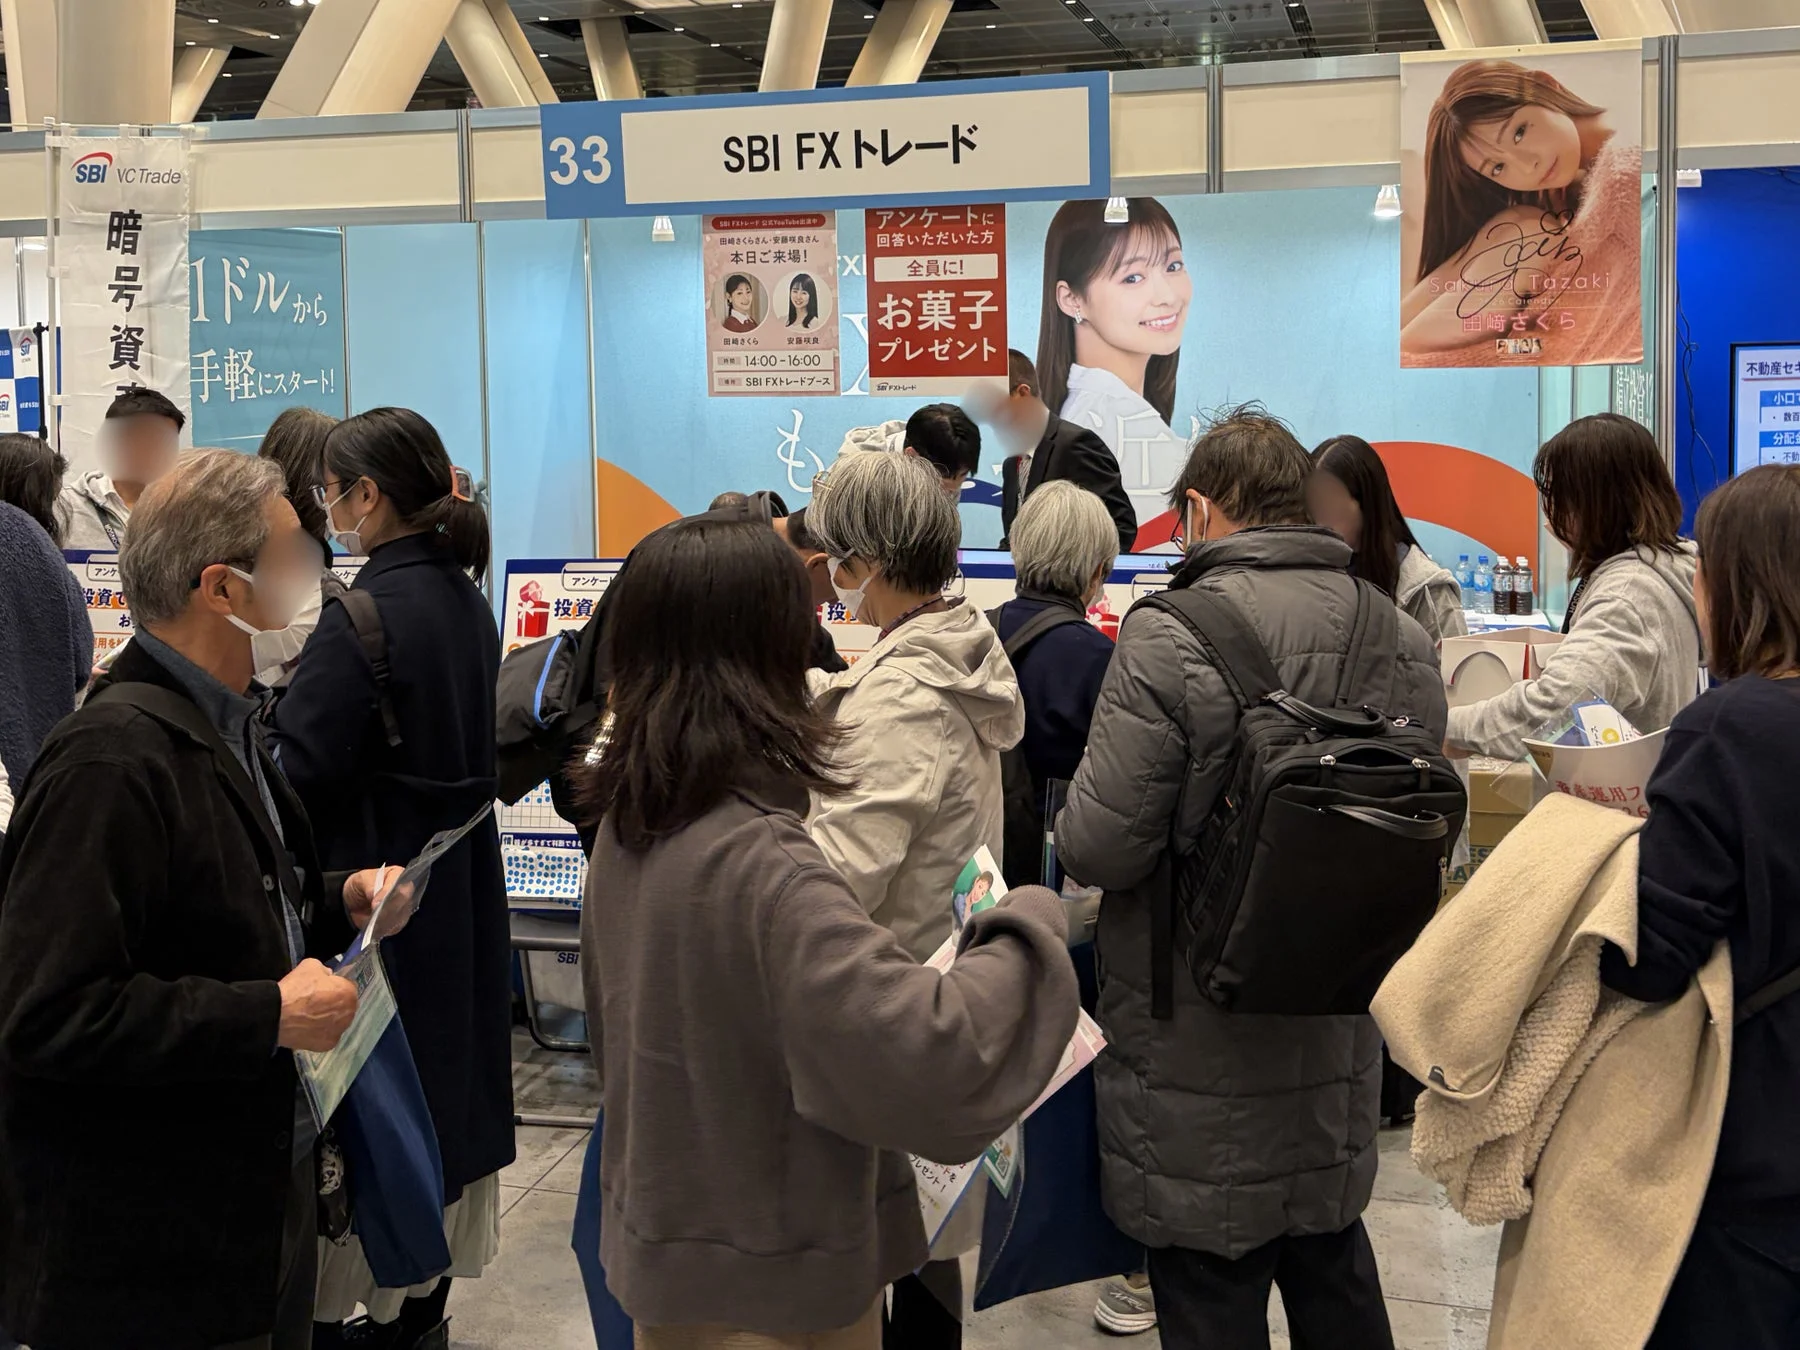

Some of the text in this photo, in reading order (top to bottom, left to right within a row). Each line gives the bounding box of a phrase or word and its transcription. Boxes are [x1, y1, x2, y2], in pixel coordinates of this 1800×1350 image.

[549, 135, 612, 186] 33
[723, 133, 780, 174] SBI
[75, 163, 182, 185] SBI VC Trade
[876, 206, 995, 230] アンケートに
[877, 229, 995, 248] 回答いただいた方
[906, 259, 964, 278] 全員に!
[190, 256, 328, 327] 1ドルから
[1529, 272, 1610, 290] Tazaki
[877, 290, 999, 332] お菓子
[878, 336, 997, 363] プレゼント
[190, 348, 335, 404] 手軽にスタート!
[745, 376, 831, 387] SBI FXトレードブース
[557, 951, 580, 965] SBI
